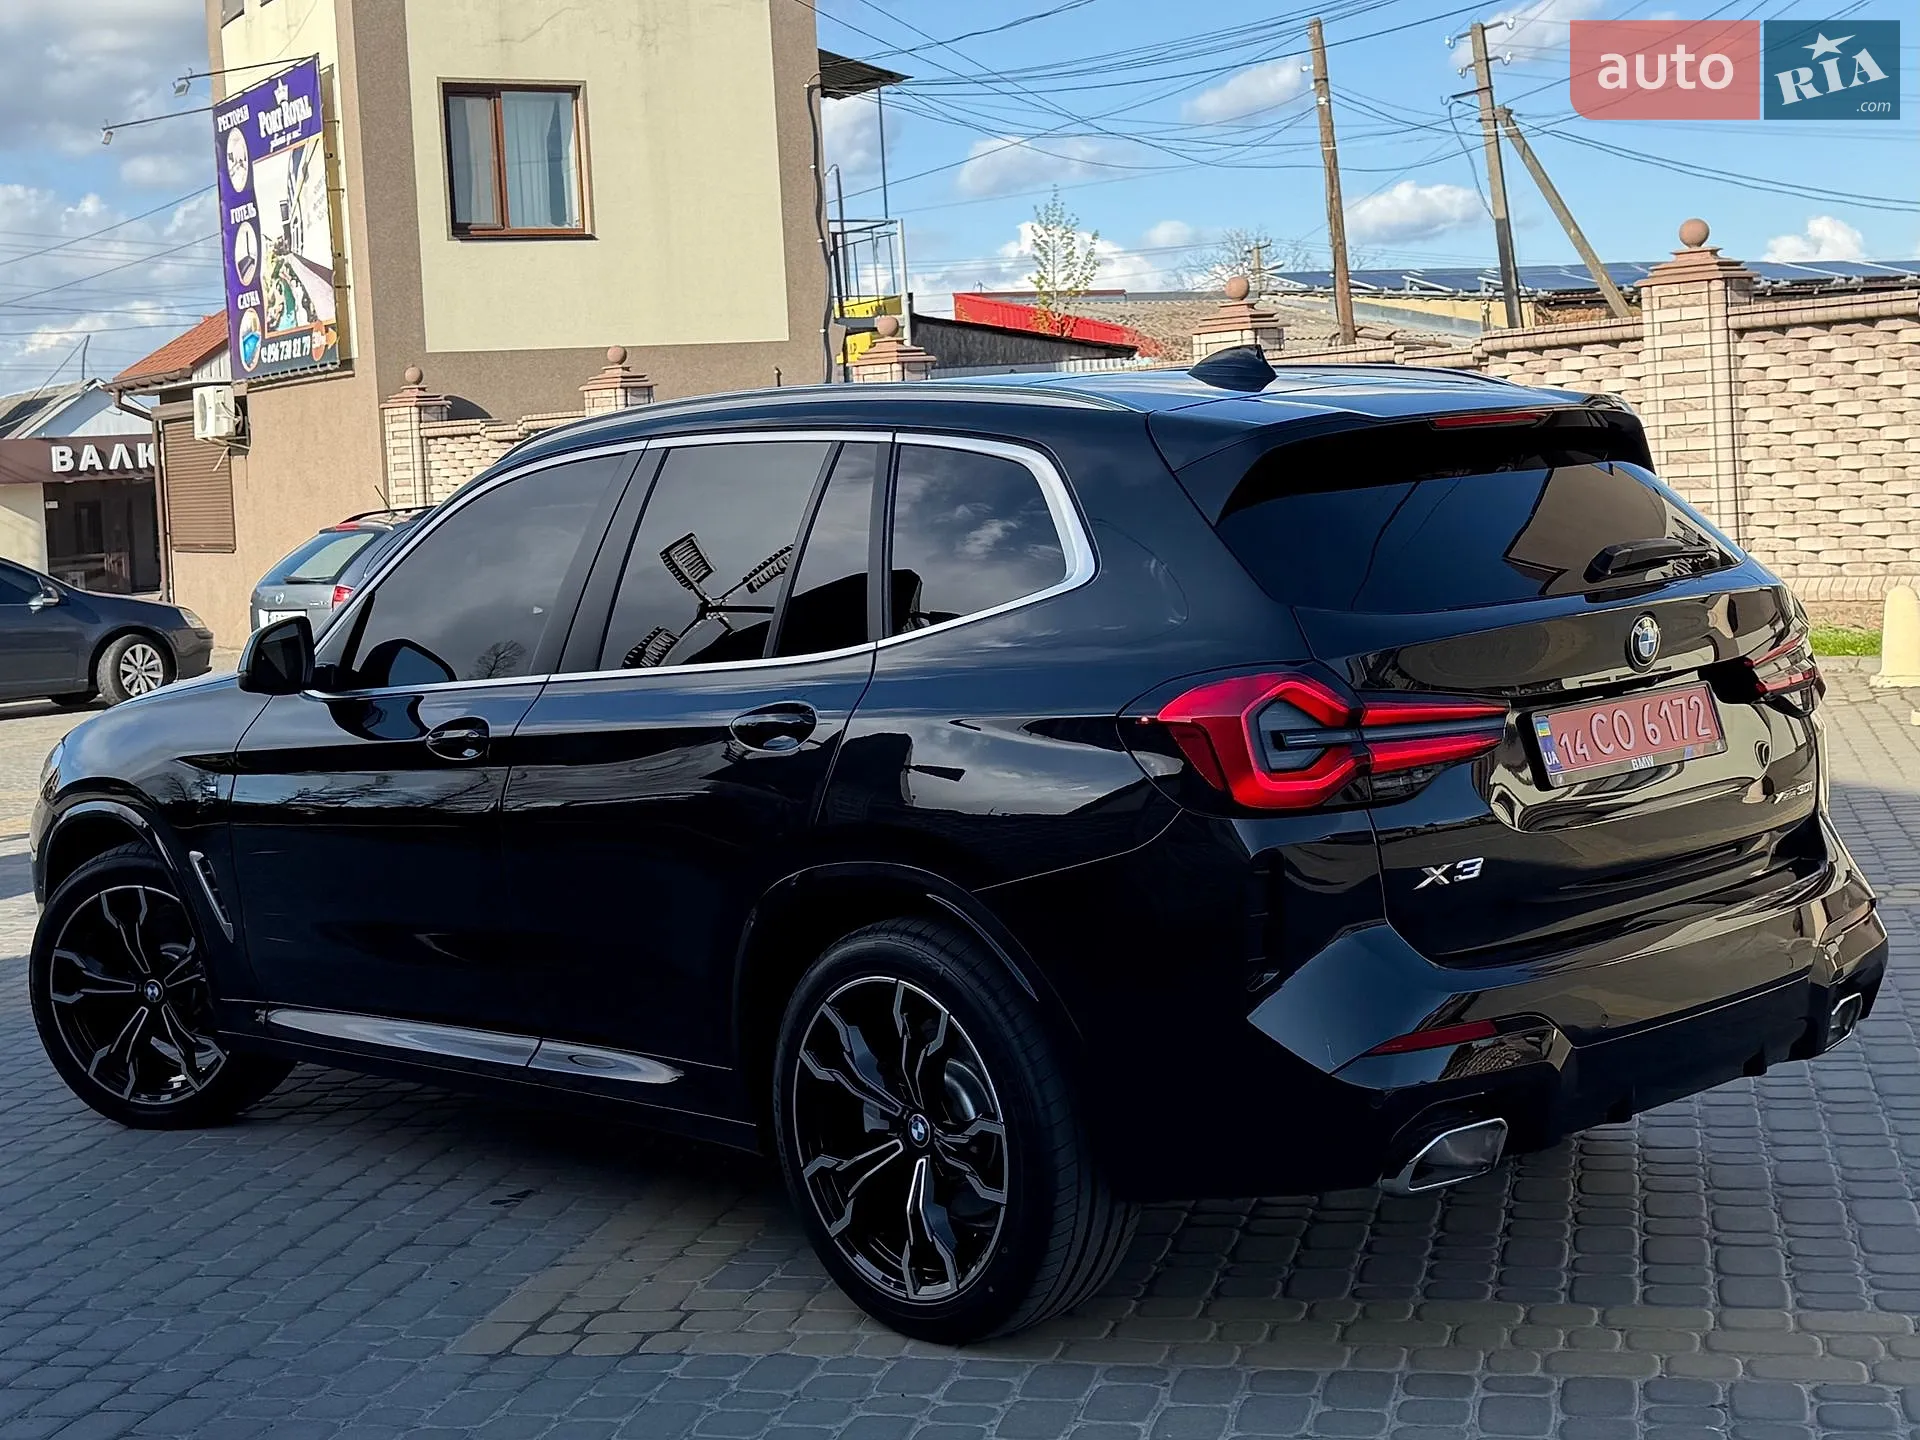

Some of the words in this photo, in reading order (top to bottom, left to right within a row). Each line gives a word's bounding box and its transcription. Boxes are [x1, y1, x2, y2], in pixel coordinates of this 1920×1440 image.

[1559, 728, 1591, 765] 14
[1590, 708, 1635, 755] CO
[1642, 695, 1713, 747] 6172
[1543, 750, 1560, 766] UA
[1411, 857, 1484, 891] X3
